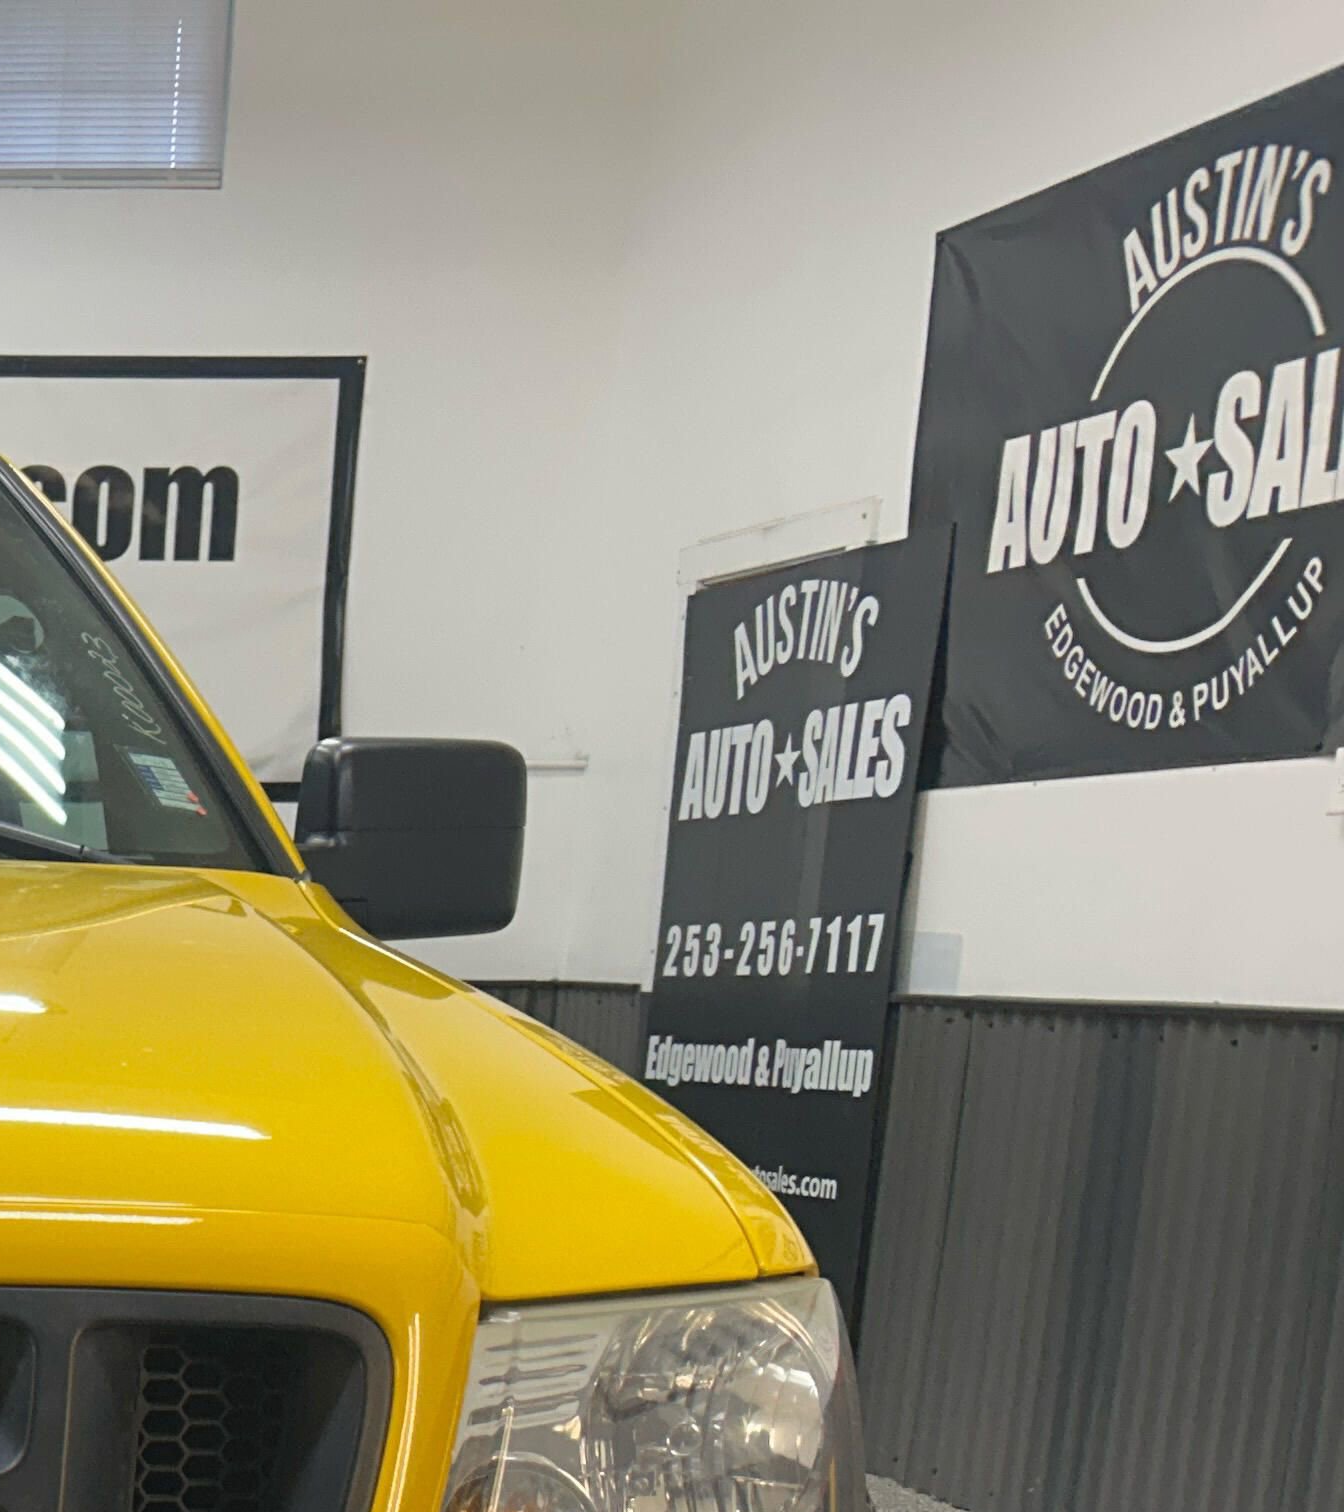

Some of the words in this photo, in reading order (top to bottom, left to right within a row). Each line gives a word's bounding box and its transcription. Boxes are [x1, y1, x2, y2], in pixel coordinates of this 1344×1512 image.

[1123, 143, 1332, 315] AUSTIN'S
[986, 399, 1157, 574] AUTO
[1206, 346, 1344, 529] SAL
[733, 579, 879, 701] AUSTIN'S
[1044, 603, 1163, 730] EDGEWOOD
[1168, 690, 1187, 729] &
[1192, 556, 1325, 722] PUYALLUP
[678, 718, 775, 822] AUTO
[797, 693, 912, 809] SALES
[662, 912, 886, 978] 253-256-7117
[644, 1034, 756, 1088] Edgewood
[755, 1045, 770, 1088] &
[771, 1038, 874, 1098] Puyallup
